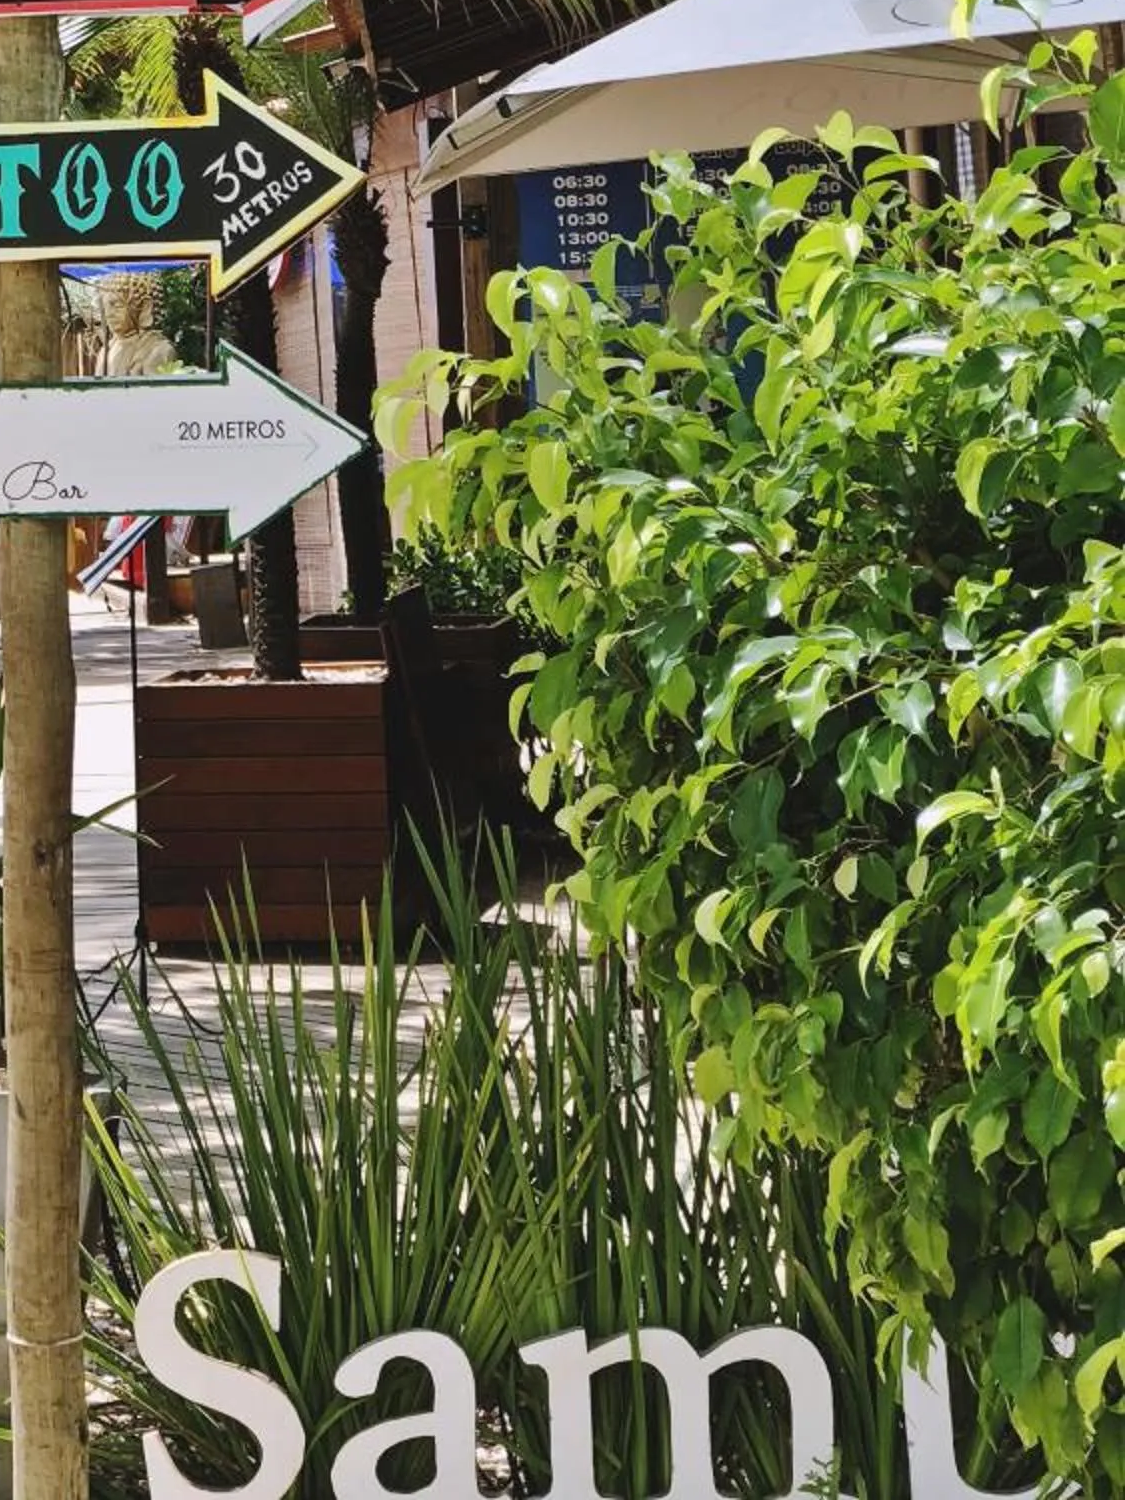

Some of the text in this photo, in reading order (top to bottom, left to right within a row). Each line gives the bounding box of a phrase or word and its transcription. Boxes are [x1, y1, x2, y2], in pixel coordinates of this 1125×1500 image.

[202, 140, 267, 204] 30
[552, 174, 608, 190] 06:30
[221, 159, 314, 248] METROS
[553, 193, 609, 209] 08:30
[557, 212, 609, 227] 10:30
[558, 230, 610, 246] 13:00
[178, 419, 286, 441] 20 METROS
[1, 460, 89, 501] Bar
